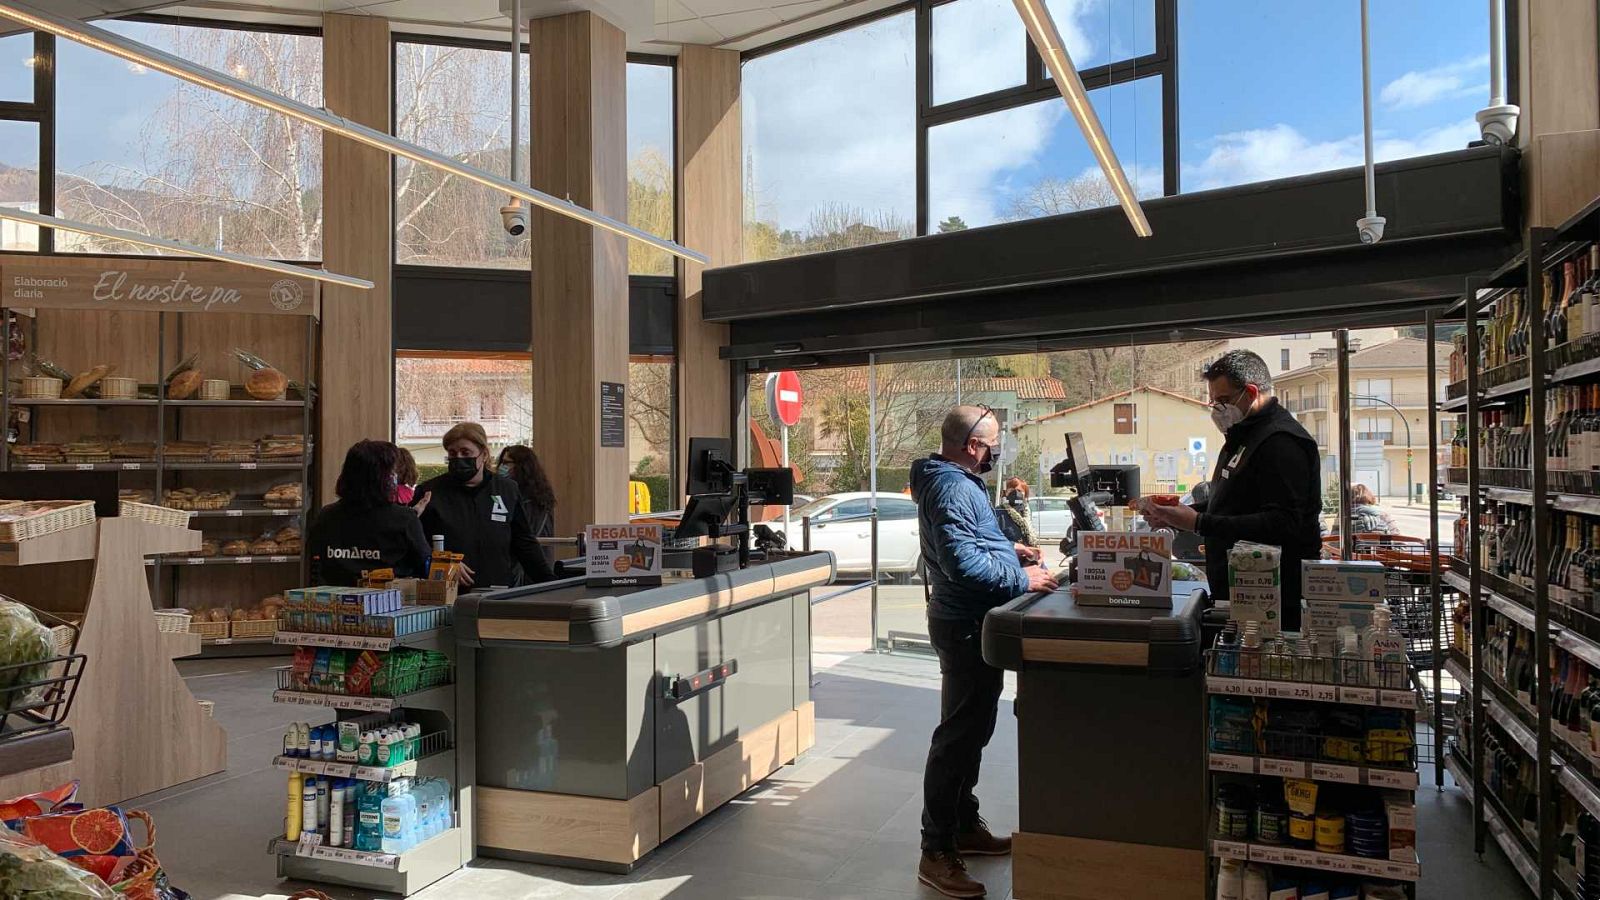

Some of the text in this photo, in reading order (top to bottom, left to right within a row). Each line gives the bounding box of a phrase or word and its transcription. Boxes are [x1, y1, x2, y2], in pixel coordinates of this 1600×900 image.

[13, 276, 69, 288] Elaboració
[13, 288, 44, 299] diaria
[93, 271, 127, 302] El
[127, 271, 208, 304] nostre
[204, 286, 242, 311] pa
[592, 527, 657, 540] REGALEM
[1084, 535, 1165, 550] REGALEM
[1294, 688, 1309, 697] 2,75
[1318, 691, 1334, 700] 2,75
